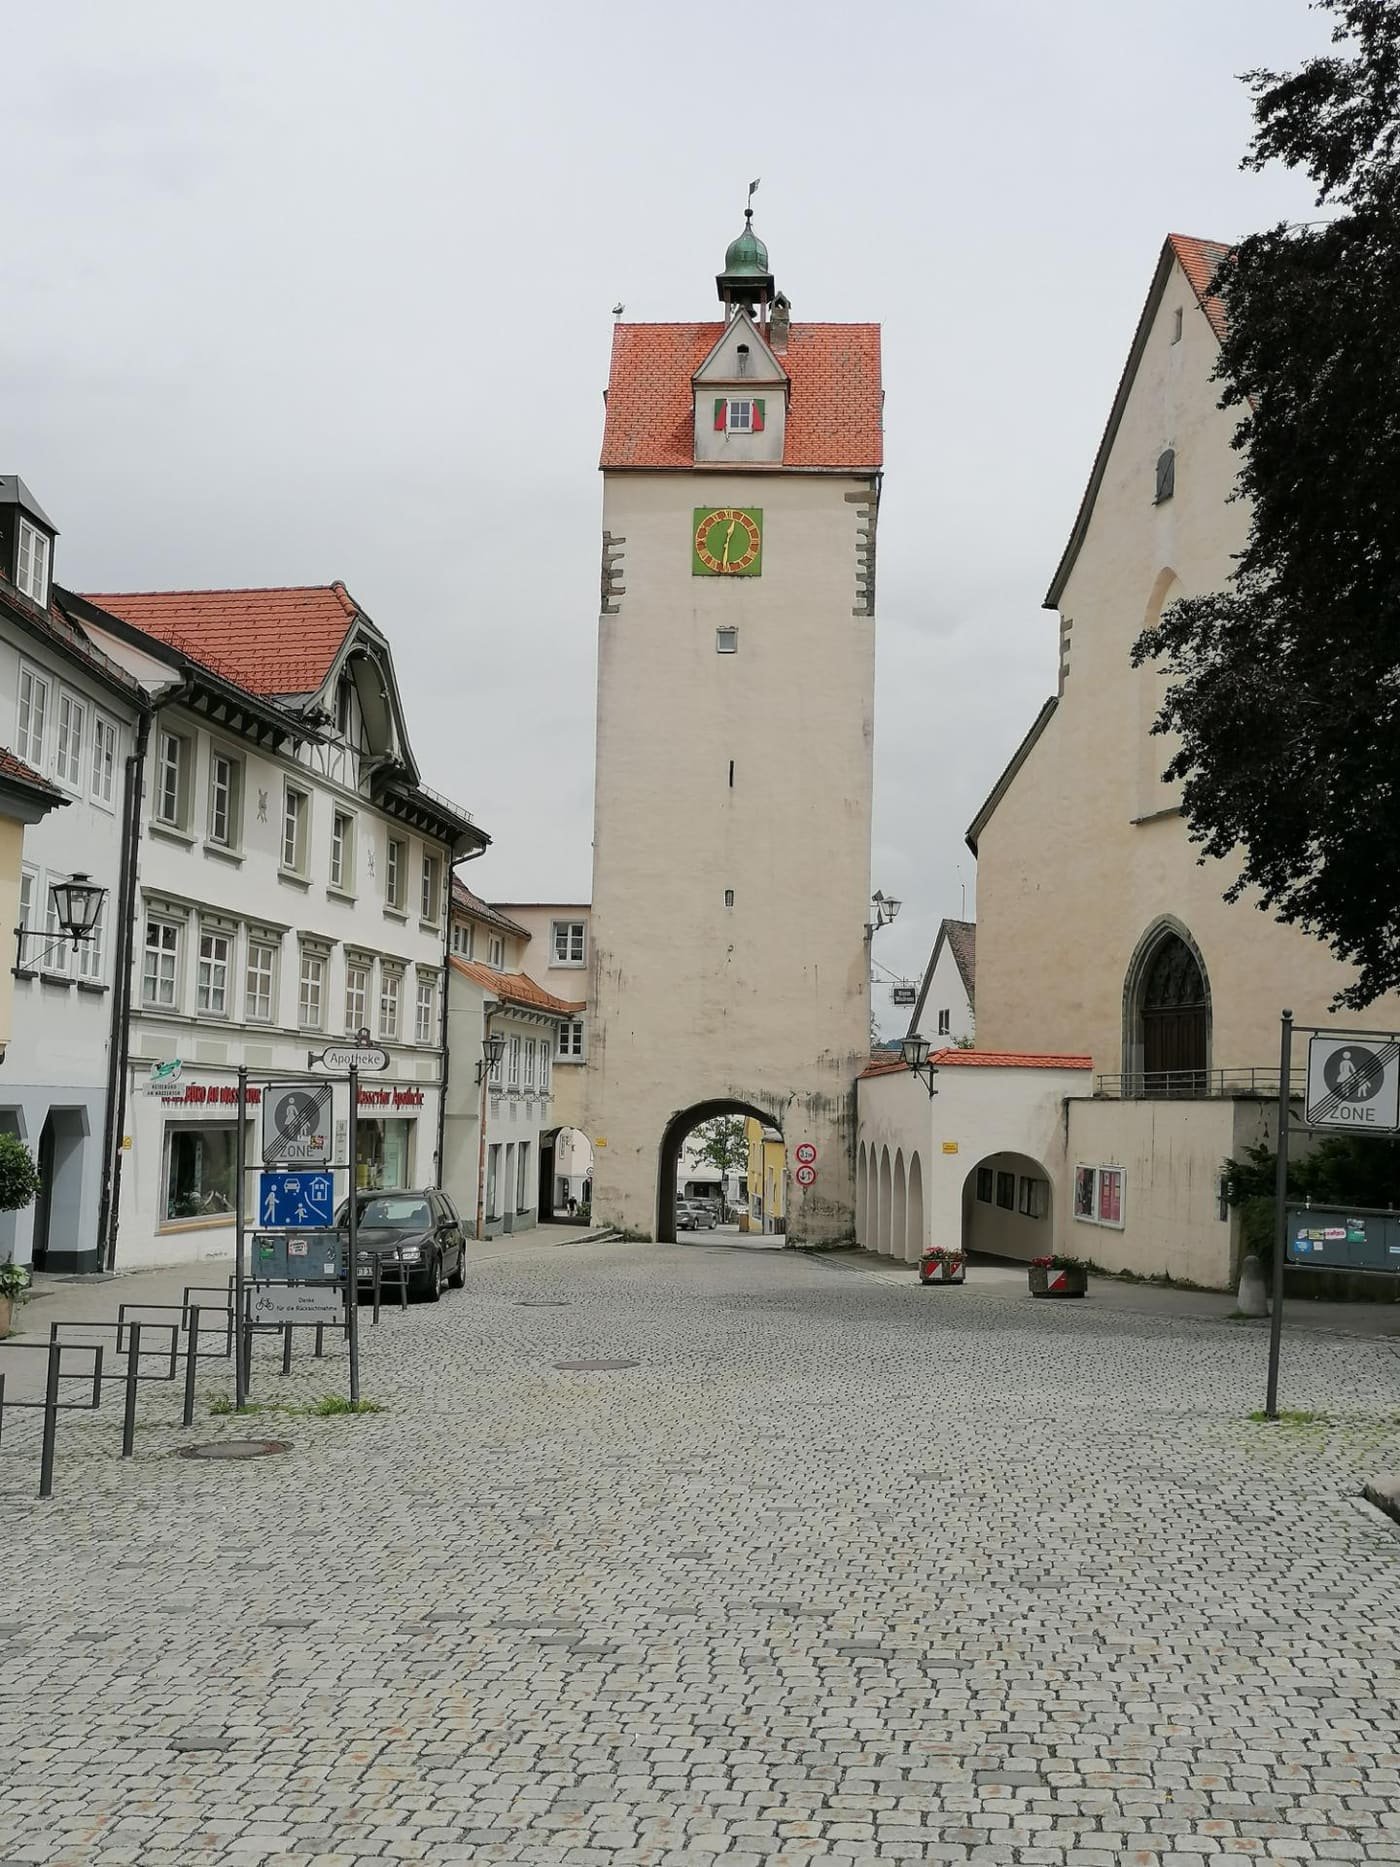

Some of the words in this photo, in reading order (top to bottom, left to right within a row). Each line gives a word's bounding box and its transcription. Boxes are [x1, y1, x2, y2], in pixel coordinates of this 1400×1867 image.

[330, 1053, 381, 1066] Apotheke
[1329, 1105, 1376, 1122] ZONE
[280, 1145, 315, 1157] ZONE
